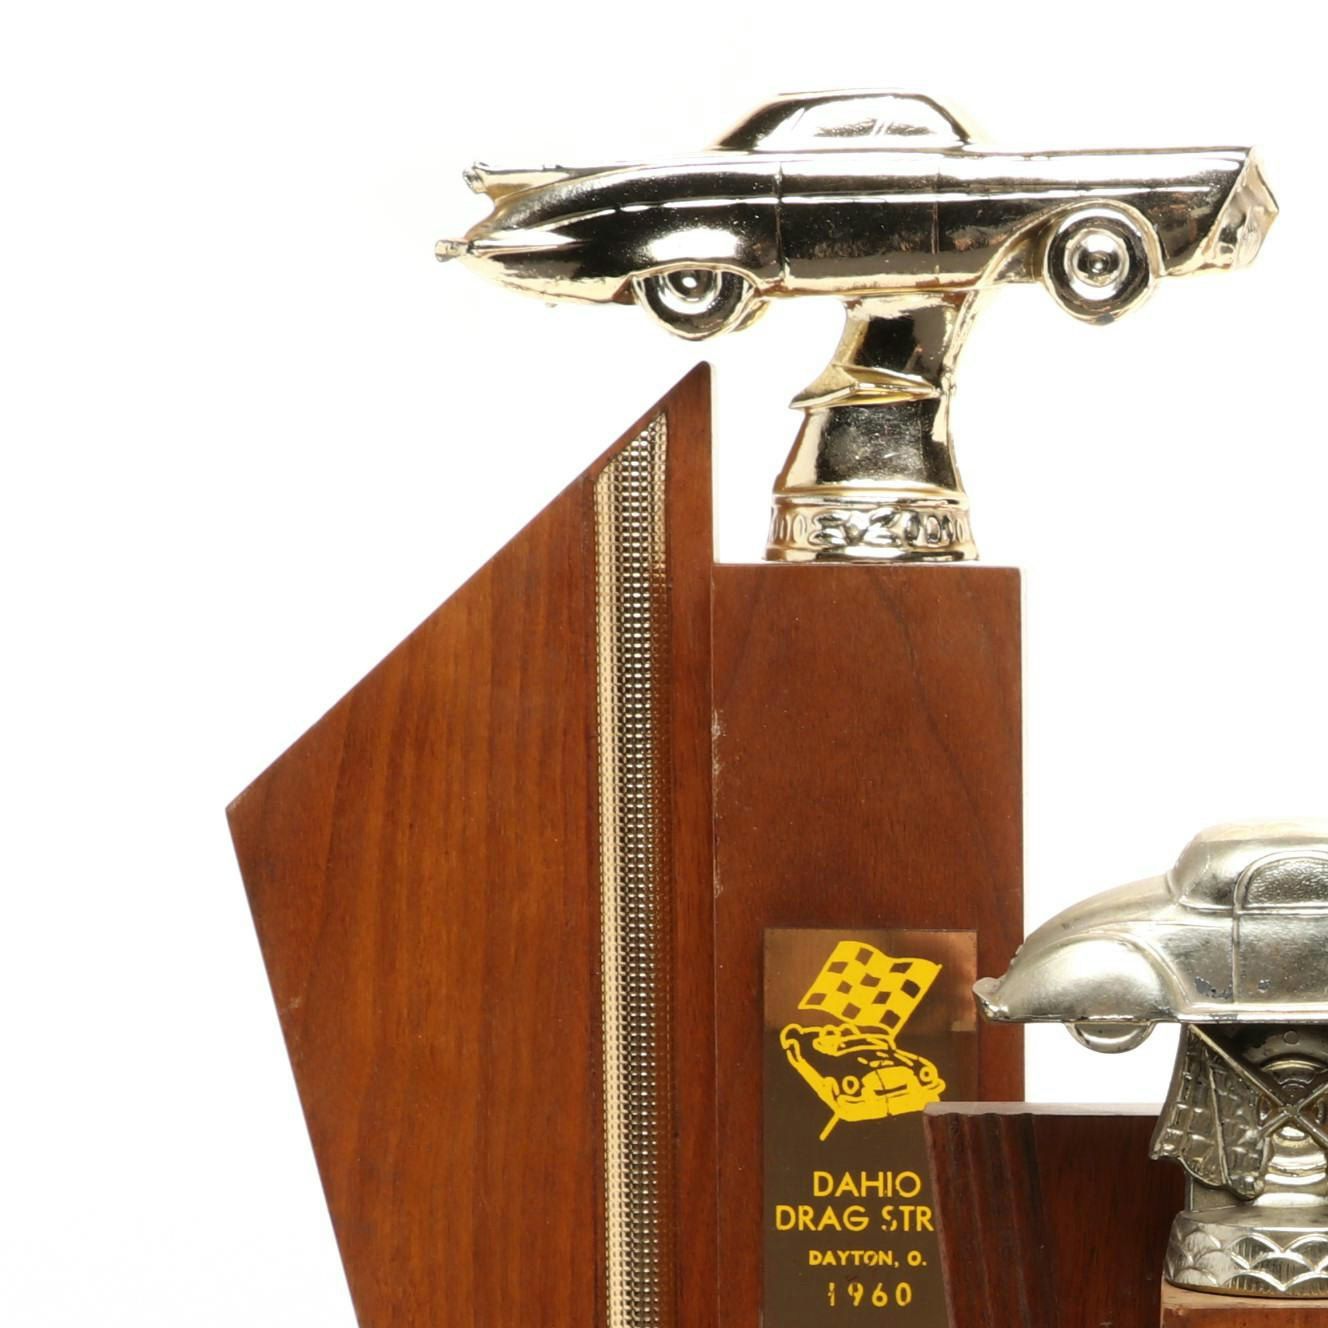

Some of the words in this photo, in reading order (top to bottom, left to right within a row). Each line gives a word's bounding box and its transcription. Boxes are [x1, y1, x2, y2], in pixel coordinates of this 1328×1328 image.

[813, 1170, 922, 1198] DAHIO
[775, 1204, 870, 1232] DRAG
[881, 1205, 936, 1232] STR
[808, 1249, 899, 1268] DAYTON,
[907, 1250, 928, 1267] O.
[827, 1281, 912, 1308] 1960
